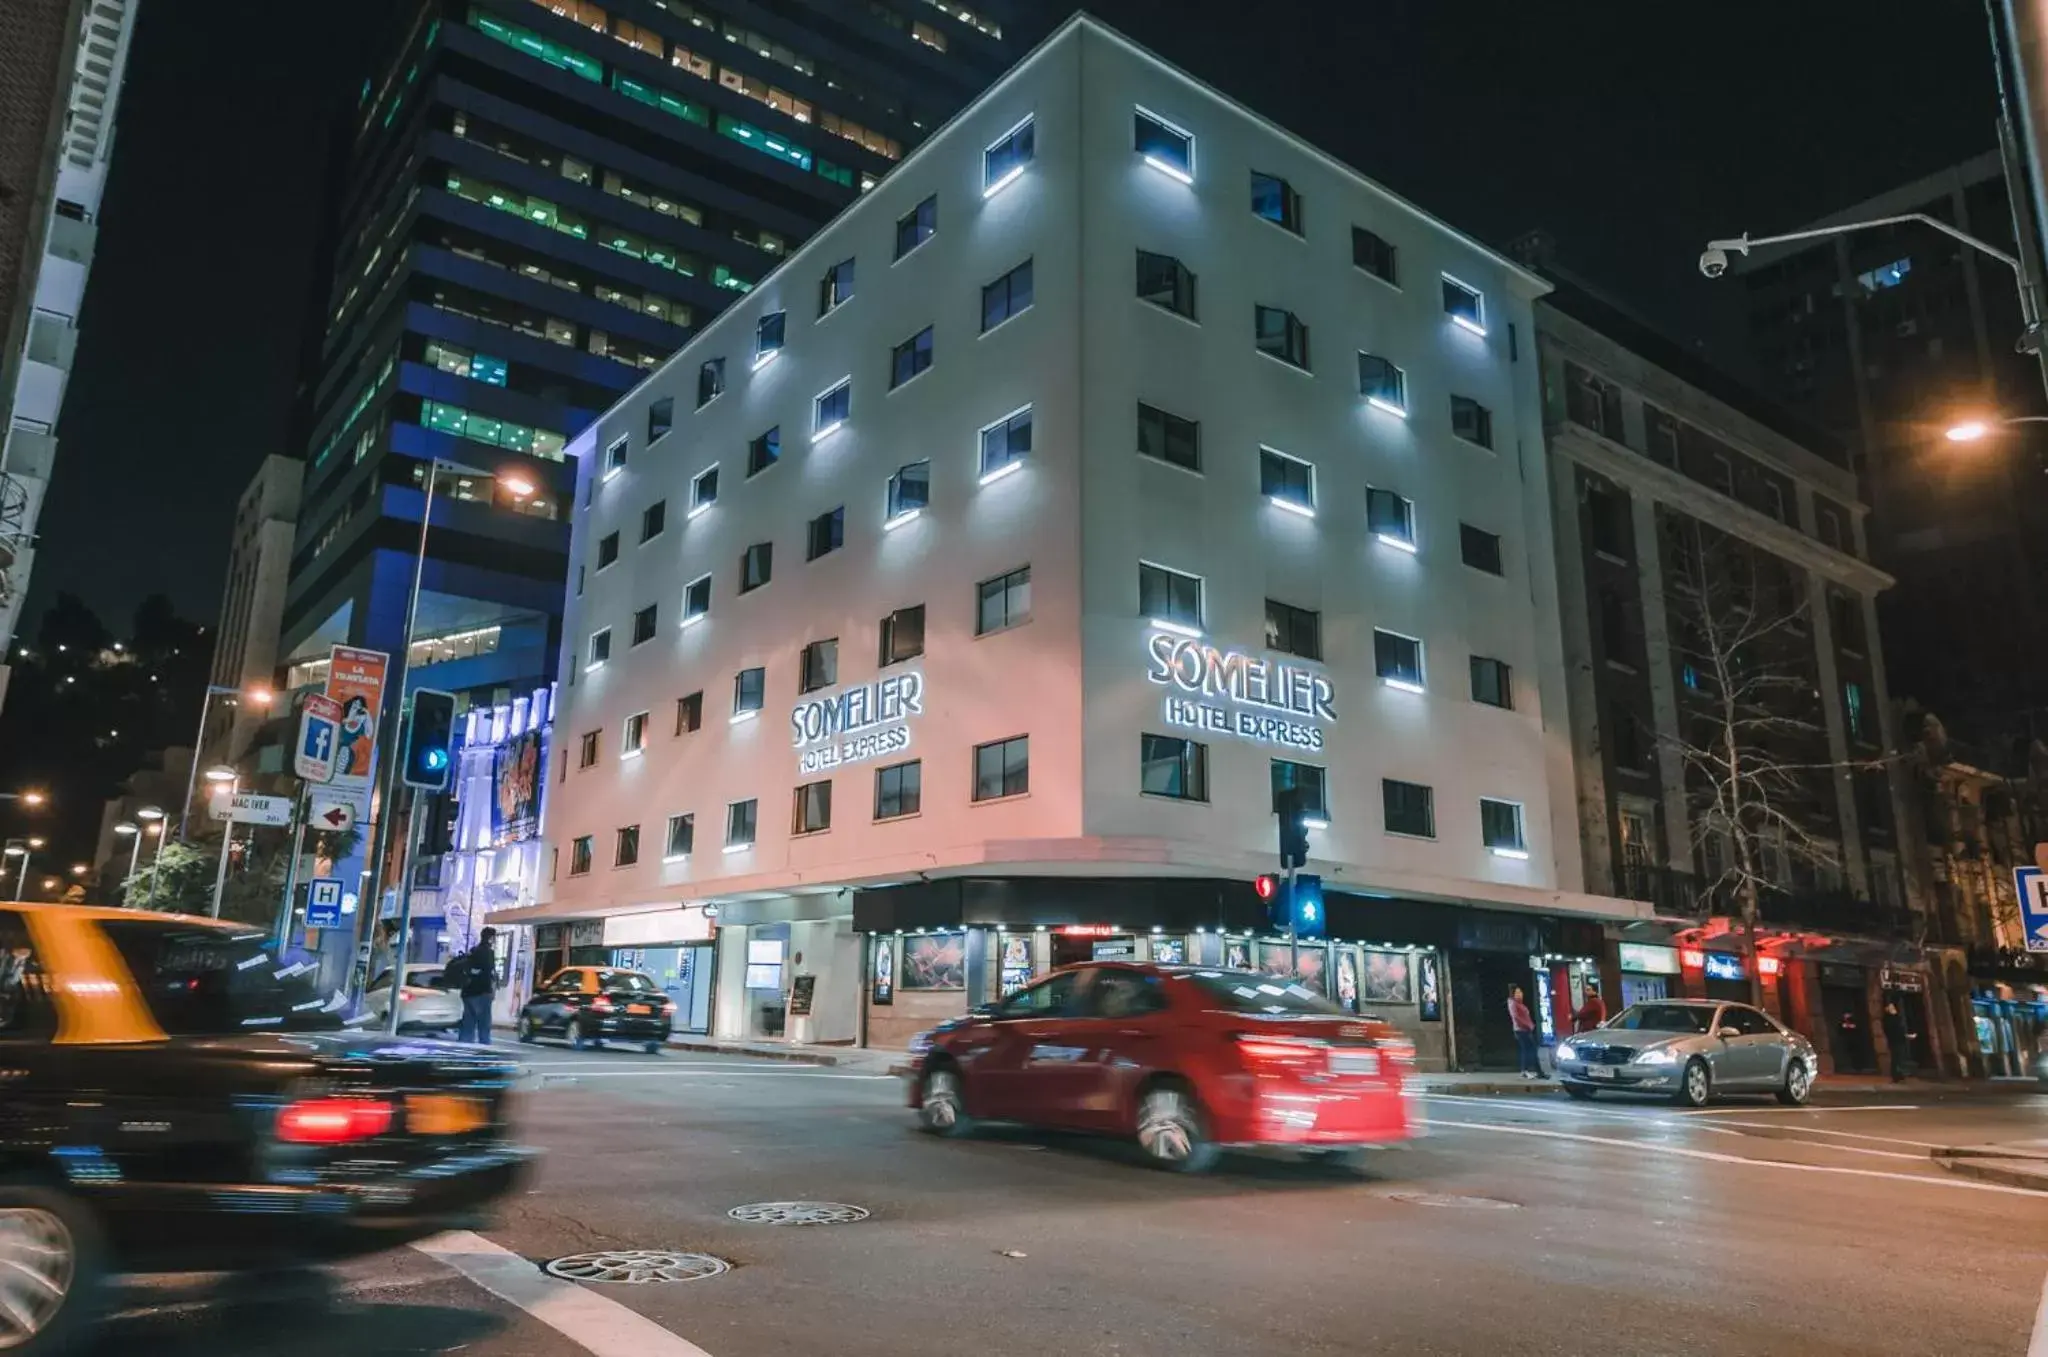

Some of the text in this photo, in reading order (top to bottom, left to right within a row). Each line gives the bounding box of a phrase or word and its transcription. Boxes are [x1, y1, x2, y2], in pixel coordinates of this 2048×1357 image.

[1148, 633, 1337, 722] SOMELIER
[791, 672, 922, 747] SOMELIER
[1165, 697, 1325, 749] HOTEL EXPRESS
[799, 726, 910, 773] HOTEL EXPRESS
[231, 797, 270, 811] MAC IVER
[319, 887, 333, 903] H
